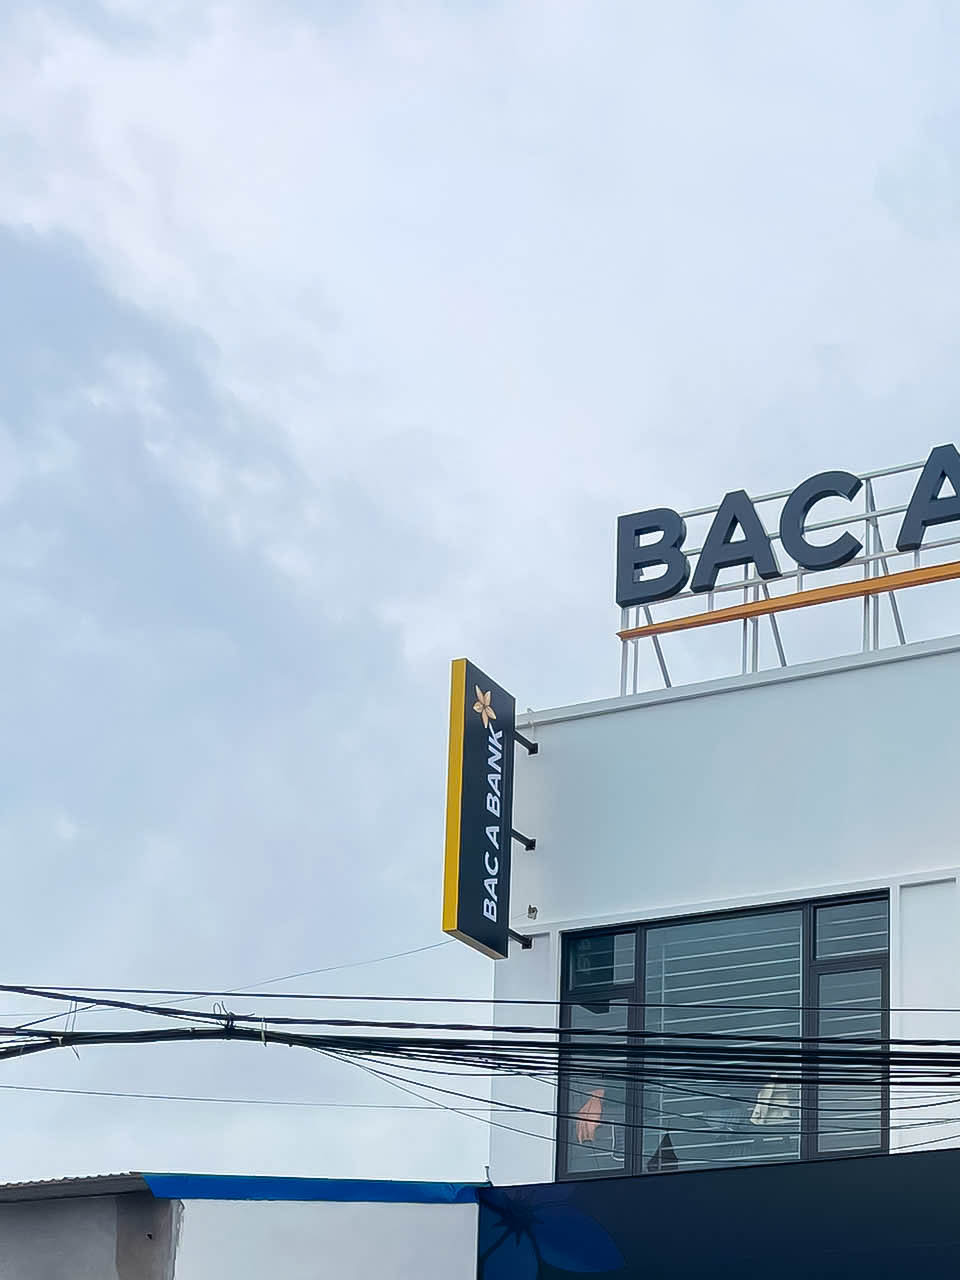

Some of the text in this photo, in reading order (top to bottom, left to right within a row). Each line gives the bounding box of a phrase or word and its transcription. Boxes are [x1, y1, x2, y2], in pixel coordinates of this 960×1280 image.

[615, 470, 863, 608] BAC
[482, 722, 503, 923] BAC A BANK
